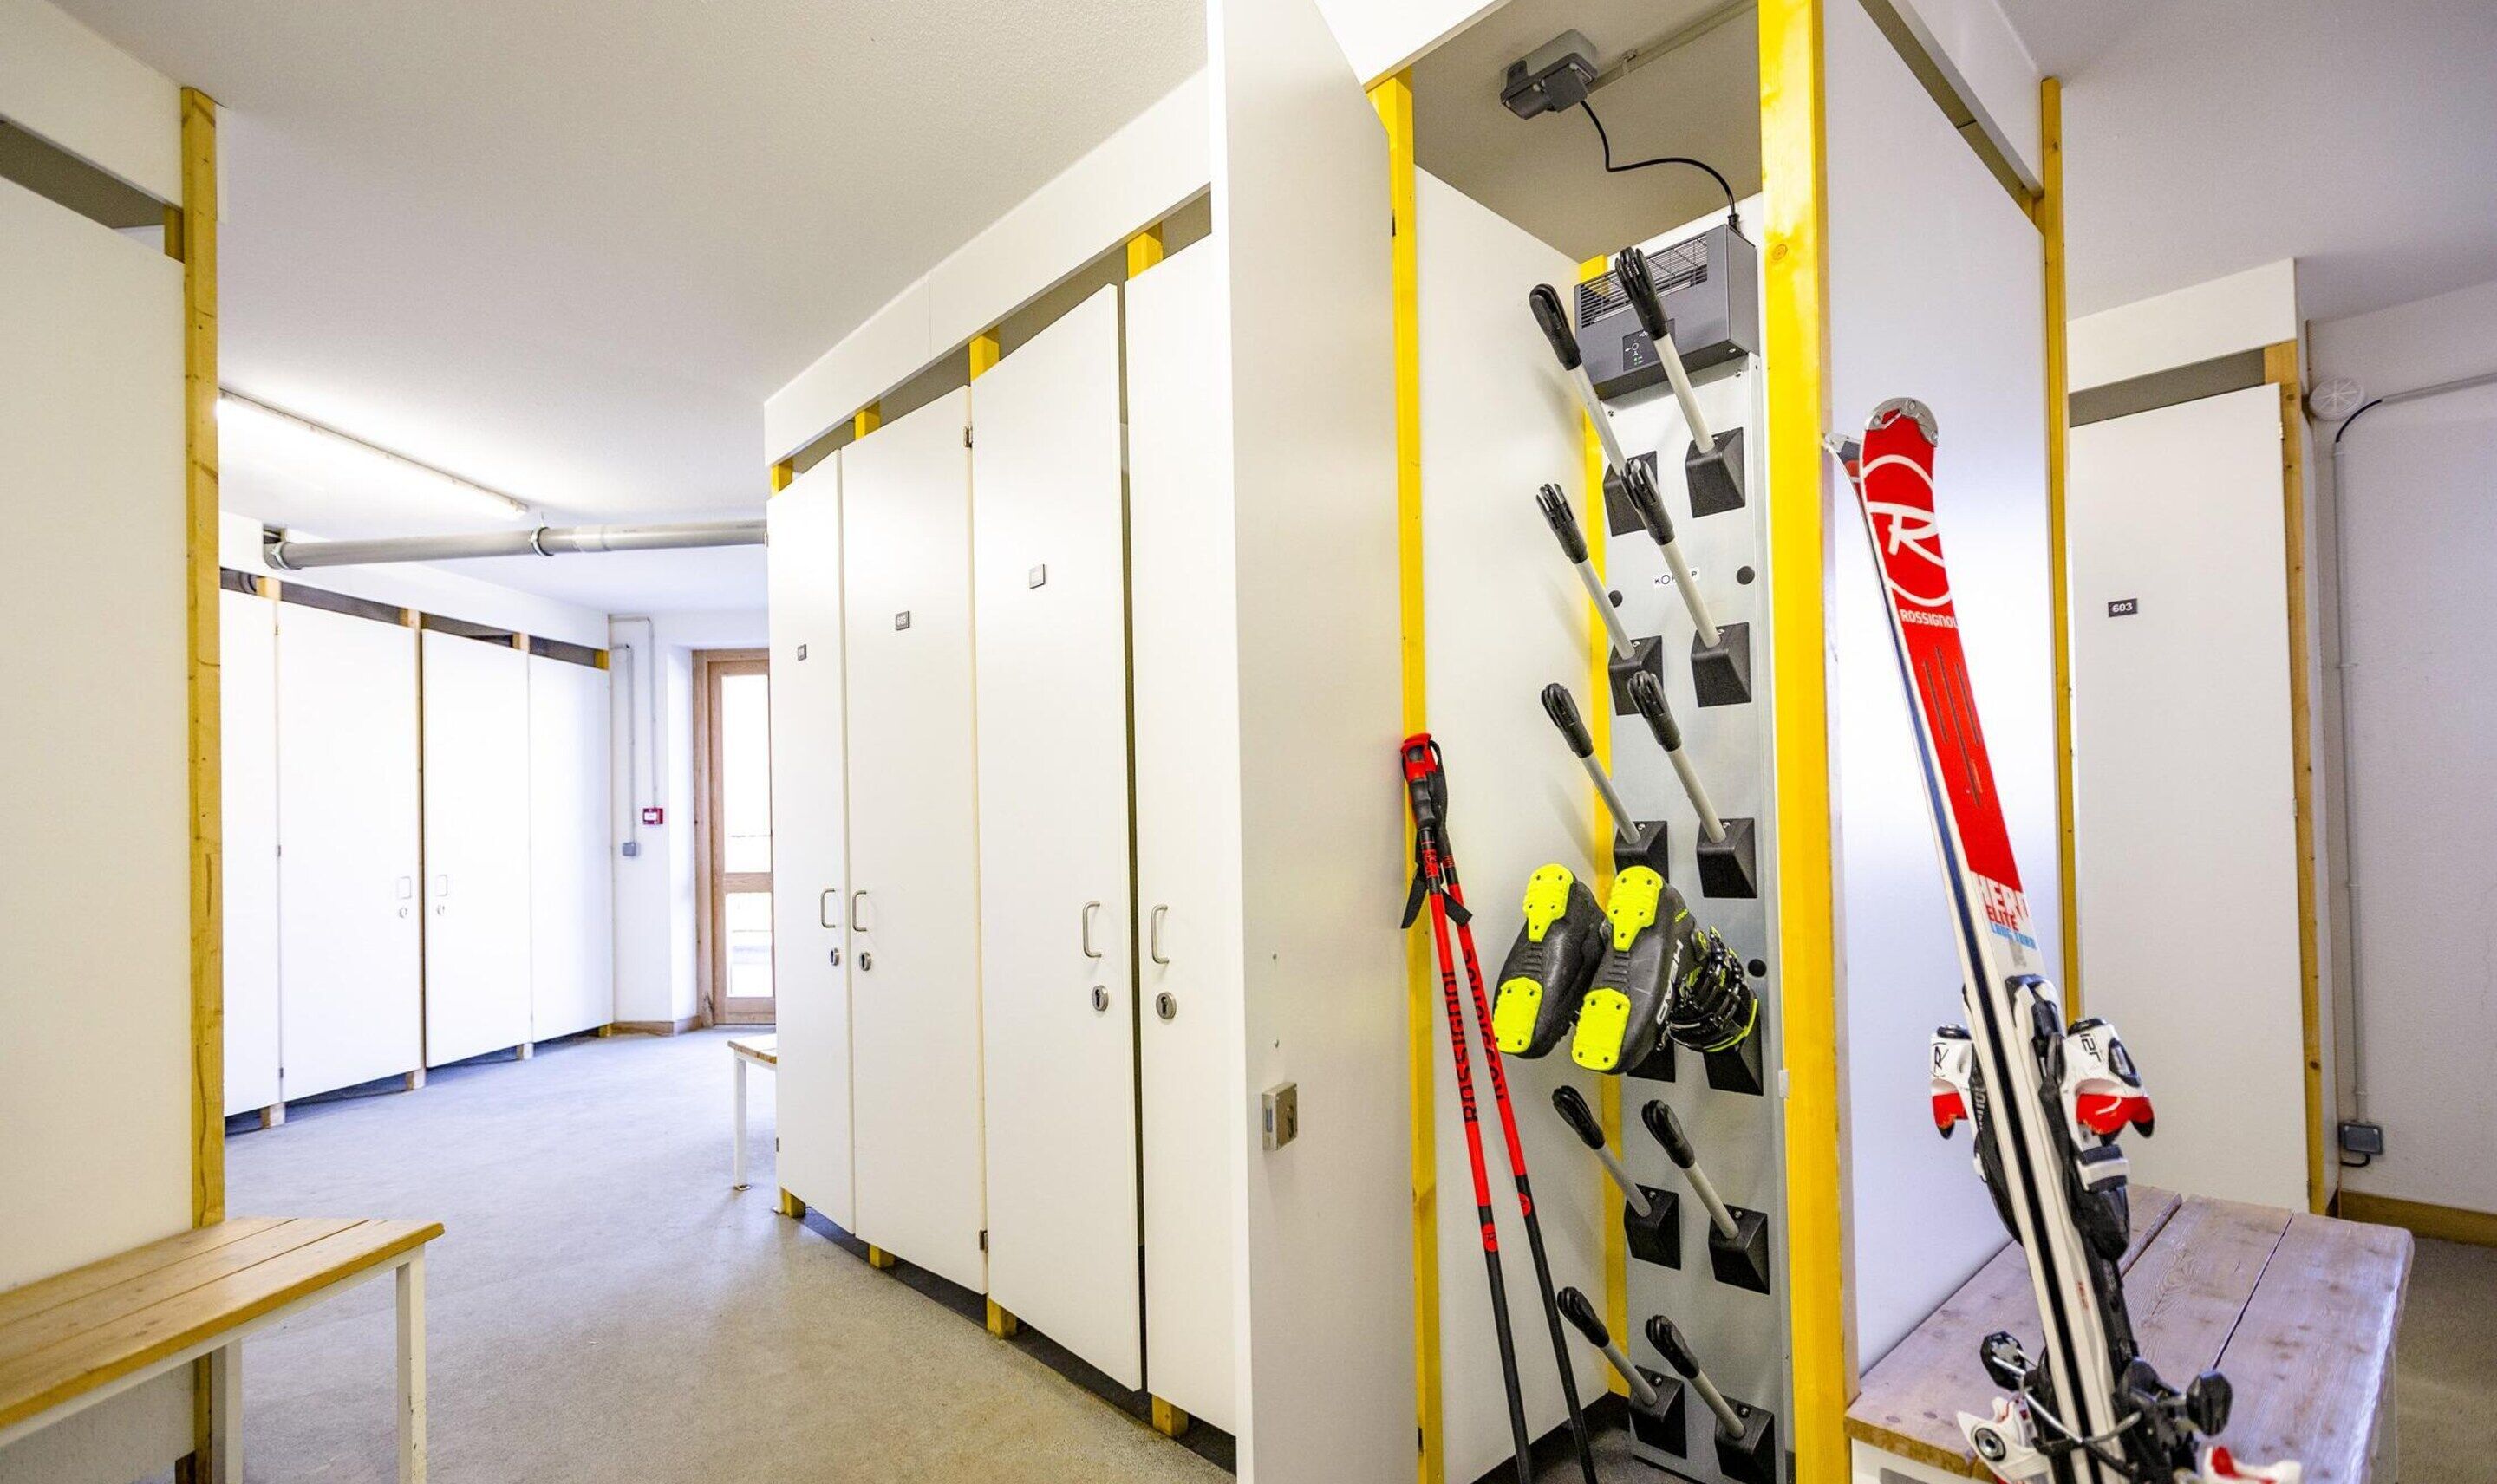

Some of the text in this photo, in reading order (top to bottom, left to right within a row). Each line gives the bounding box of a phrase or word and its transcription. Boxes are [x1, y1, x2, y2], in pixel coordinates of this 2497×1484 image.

[2112, 602, 2133, 613] 603
[1985, 904, 2019, 932] ELITE
[1656, 939, 1684, 1025] HEAD
